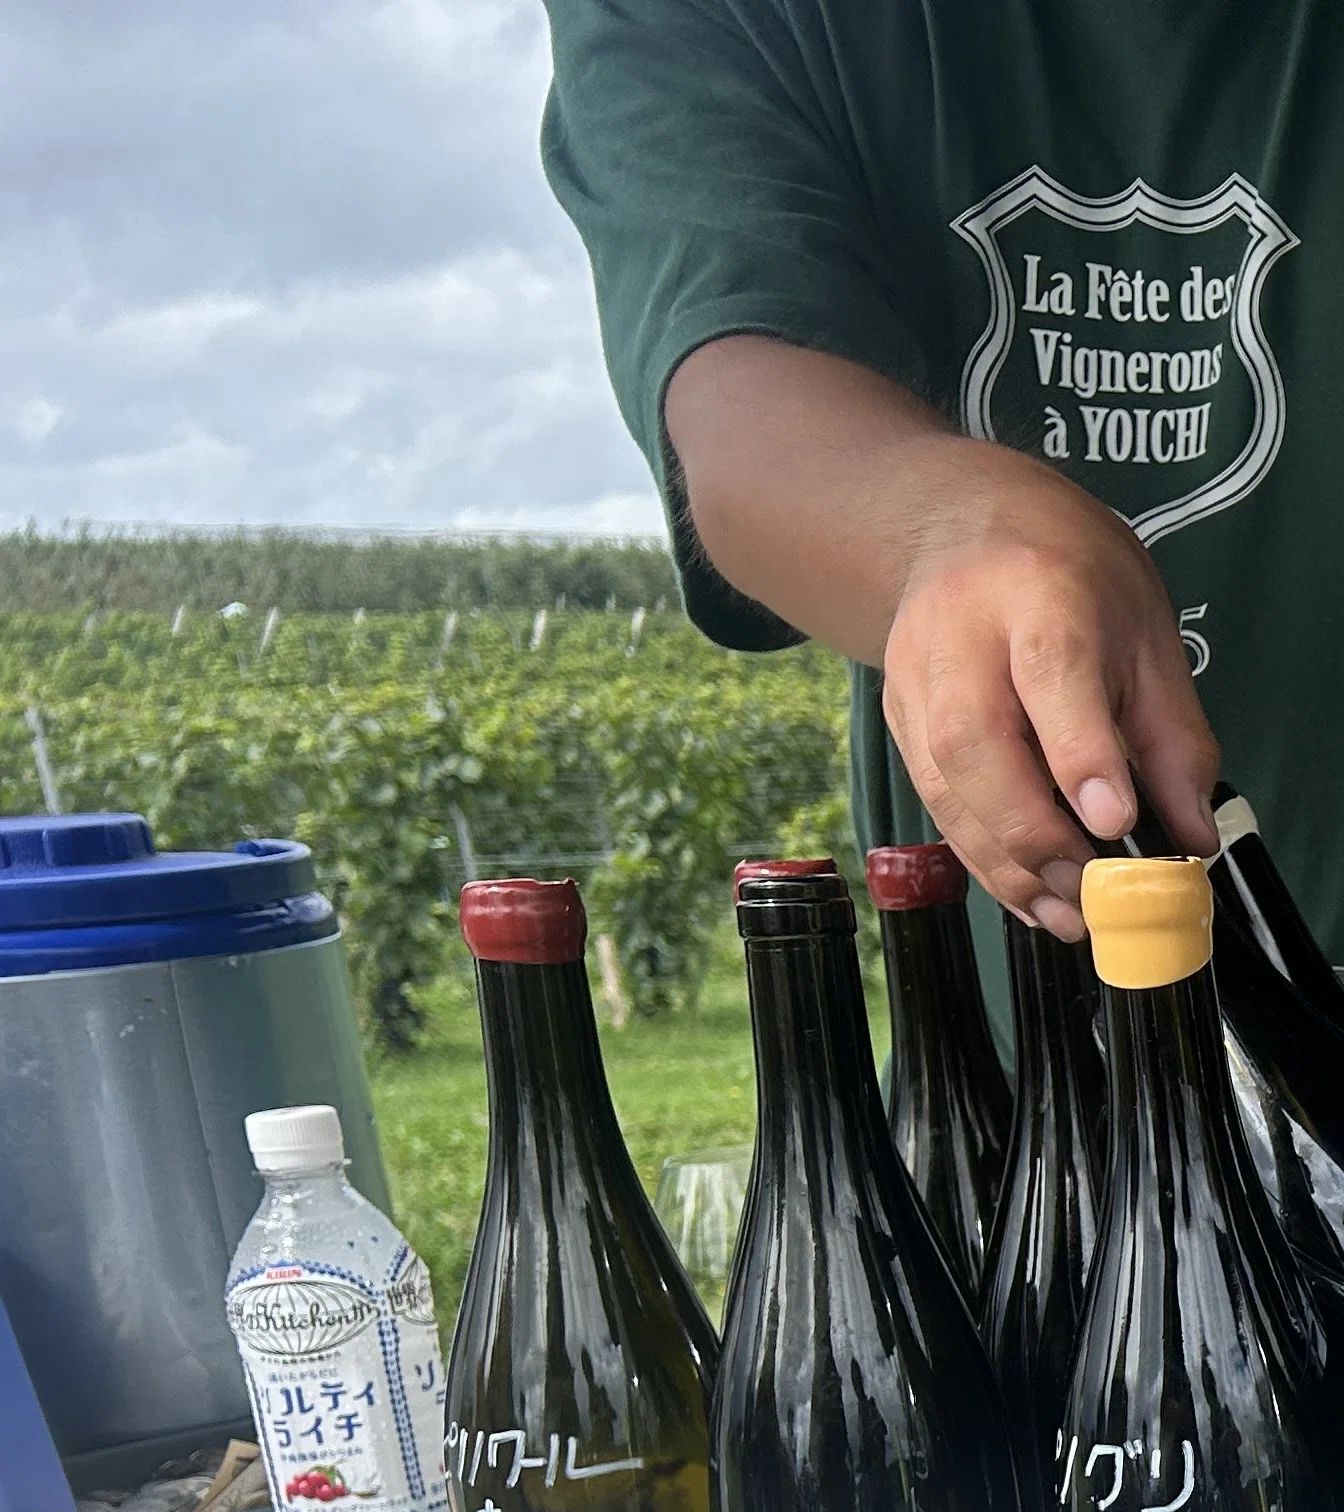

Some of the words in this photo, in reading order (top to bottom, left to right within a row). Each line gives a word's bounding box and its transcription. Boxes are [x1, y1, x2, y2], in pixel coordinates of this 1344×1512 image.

[1022, 254, 1075, 317] La
[1085, 262, 1170, 322] Fête
[1180, 266, 1236, 323] des
[1029, 327, 1223, 399] Vignerons
[1043, 407, 1070, 460] à
[1080, 402, 1211, 463] YOICHI
[273, 1411, 364, 1449] ライチ
